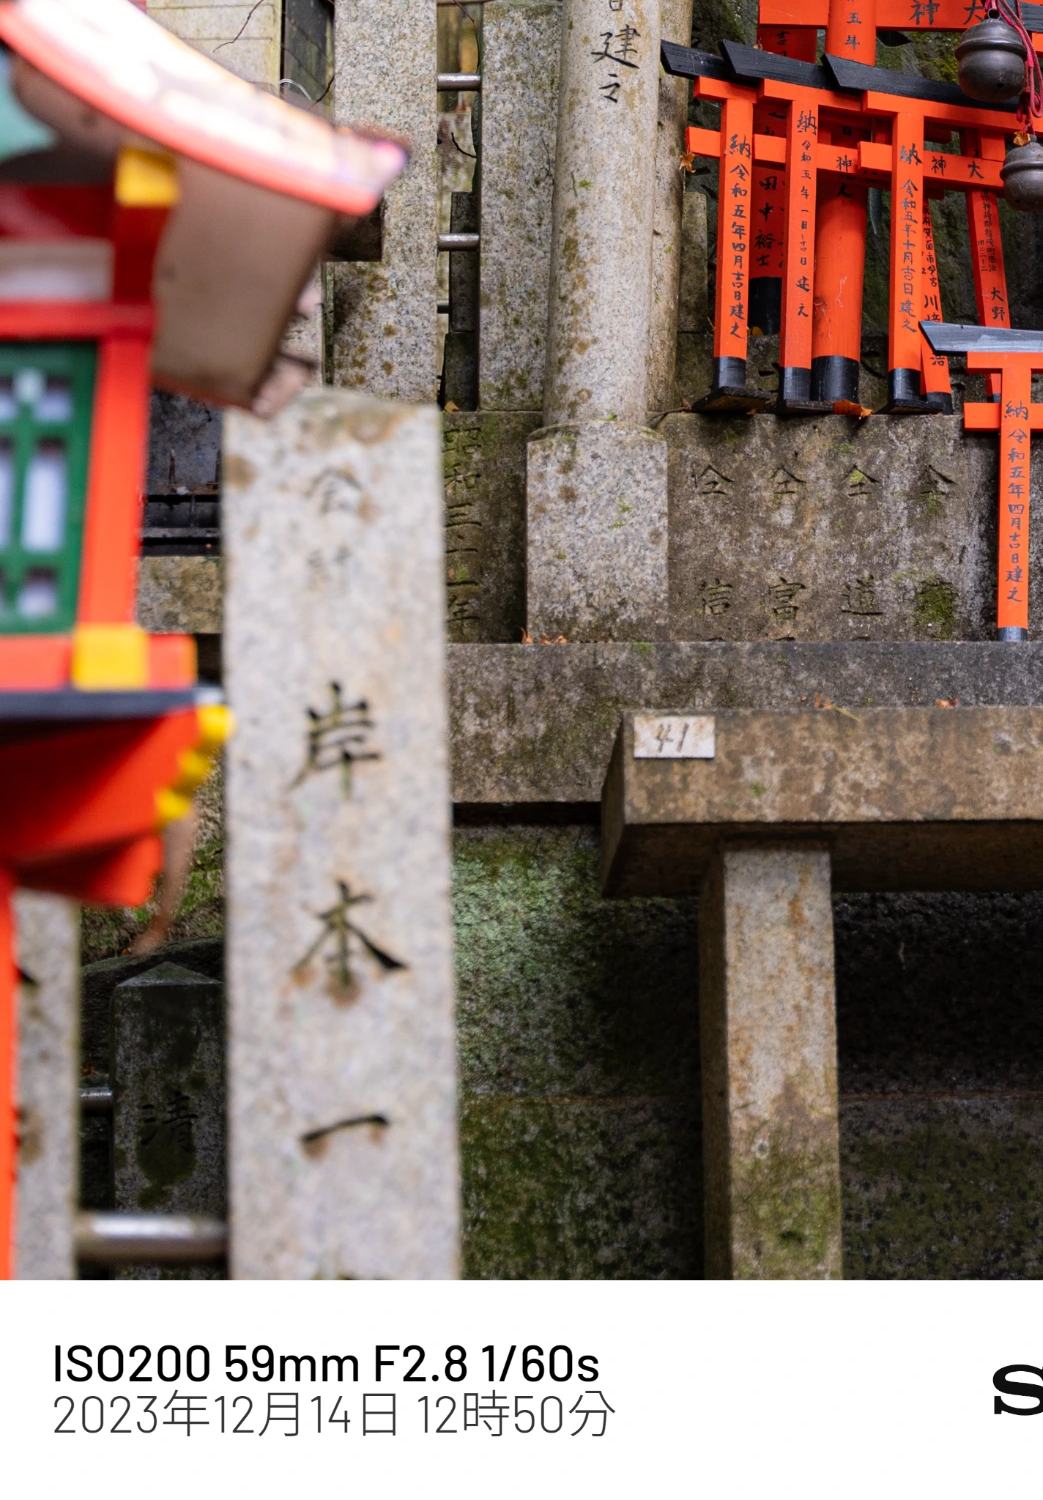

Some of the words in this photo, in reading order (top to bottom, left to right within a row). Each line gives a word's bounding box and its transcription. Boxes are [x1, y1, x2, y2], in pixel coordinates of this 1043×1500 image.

[1004, 400, 1030, 422] 納
[288, 680, 409, 1279] 岸本一
